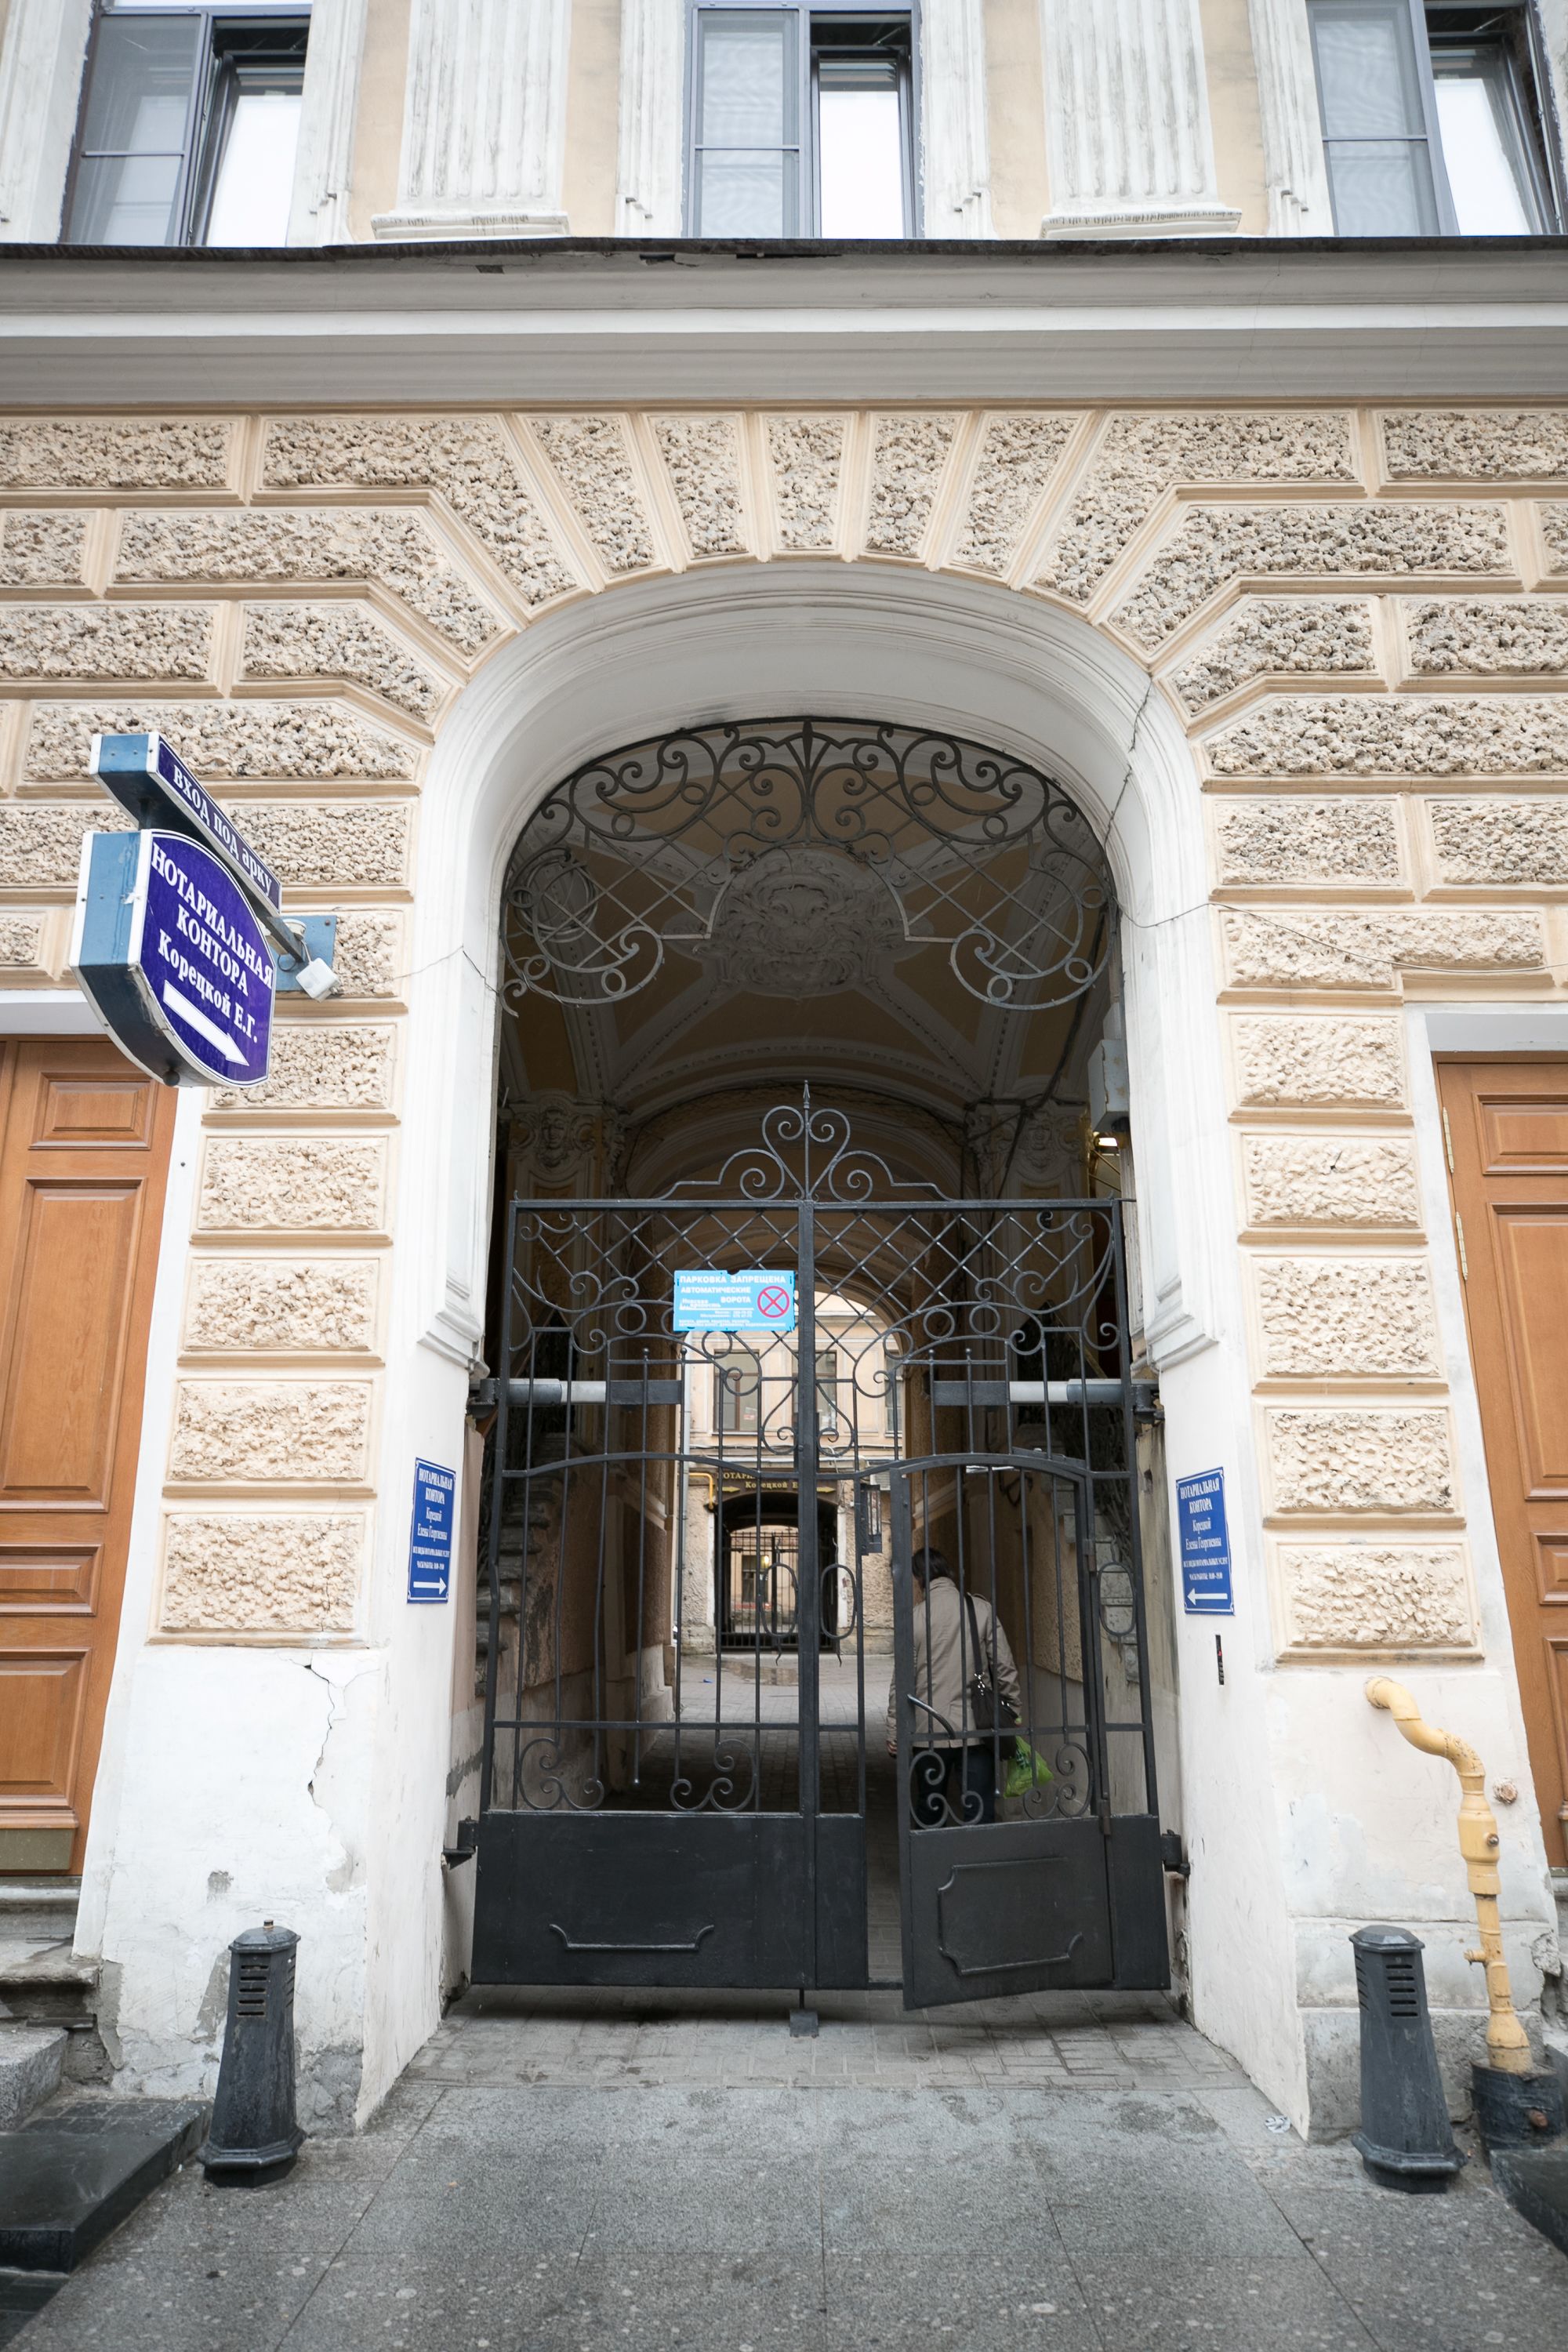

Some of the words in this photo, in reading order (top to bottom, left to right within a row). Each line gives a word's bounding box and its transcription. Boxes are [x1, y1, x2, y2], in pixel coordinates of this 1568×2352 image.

[242, 848, 272, 897] арку
[151, 842, 273, 989] НОТАРИАЛЬНАЯ
[176, 904, 249, 996] КОНТОРА
[158, 928, 230, 1018] Корецкой
[234, 1002, 258, 1044] Е.Г.
[680, 1276, 727, 1284] ПАРКОВКА
[731, 1276, 786, 1285] ЗАПРЕЩЕНА
[419, 1467, 452, 1491] НОТАРИАЛЬНАЯ
[746, 1481, 788, 1490] Коецкой
[1180, 1477, 1220, 1499] НОТАРИАЛЬНАЯ
[1189, 1497, 1212, 1514] КОНТОРА
